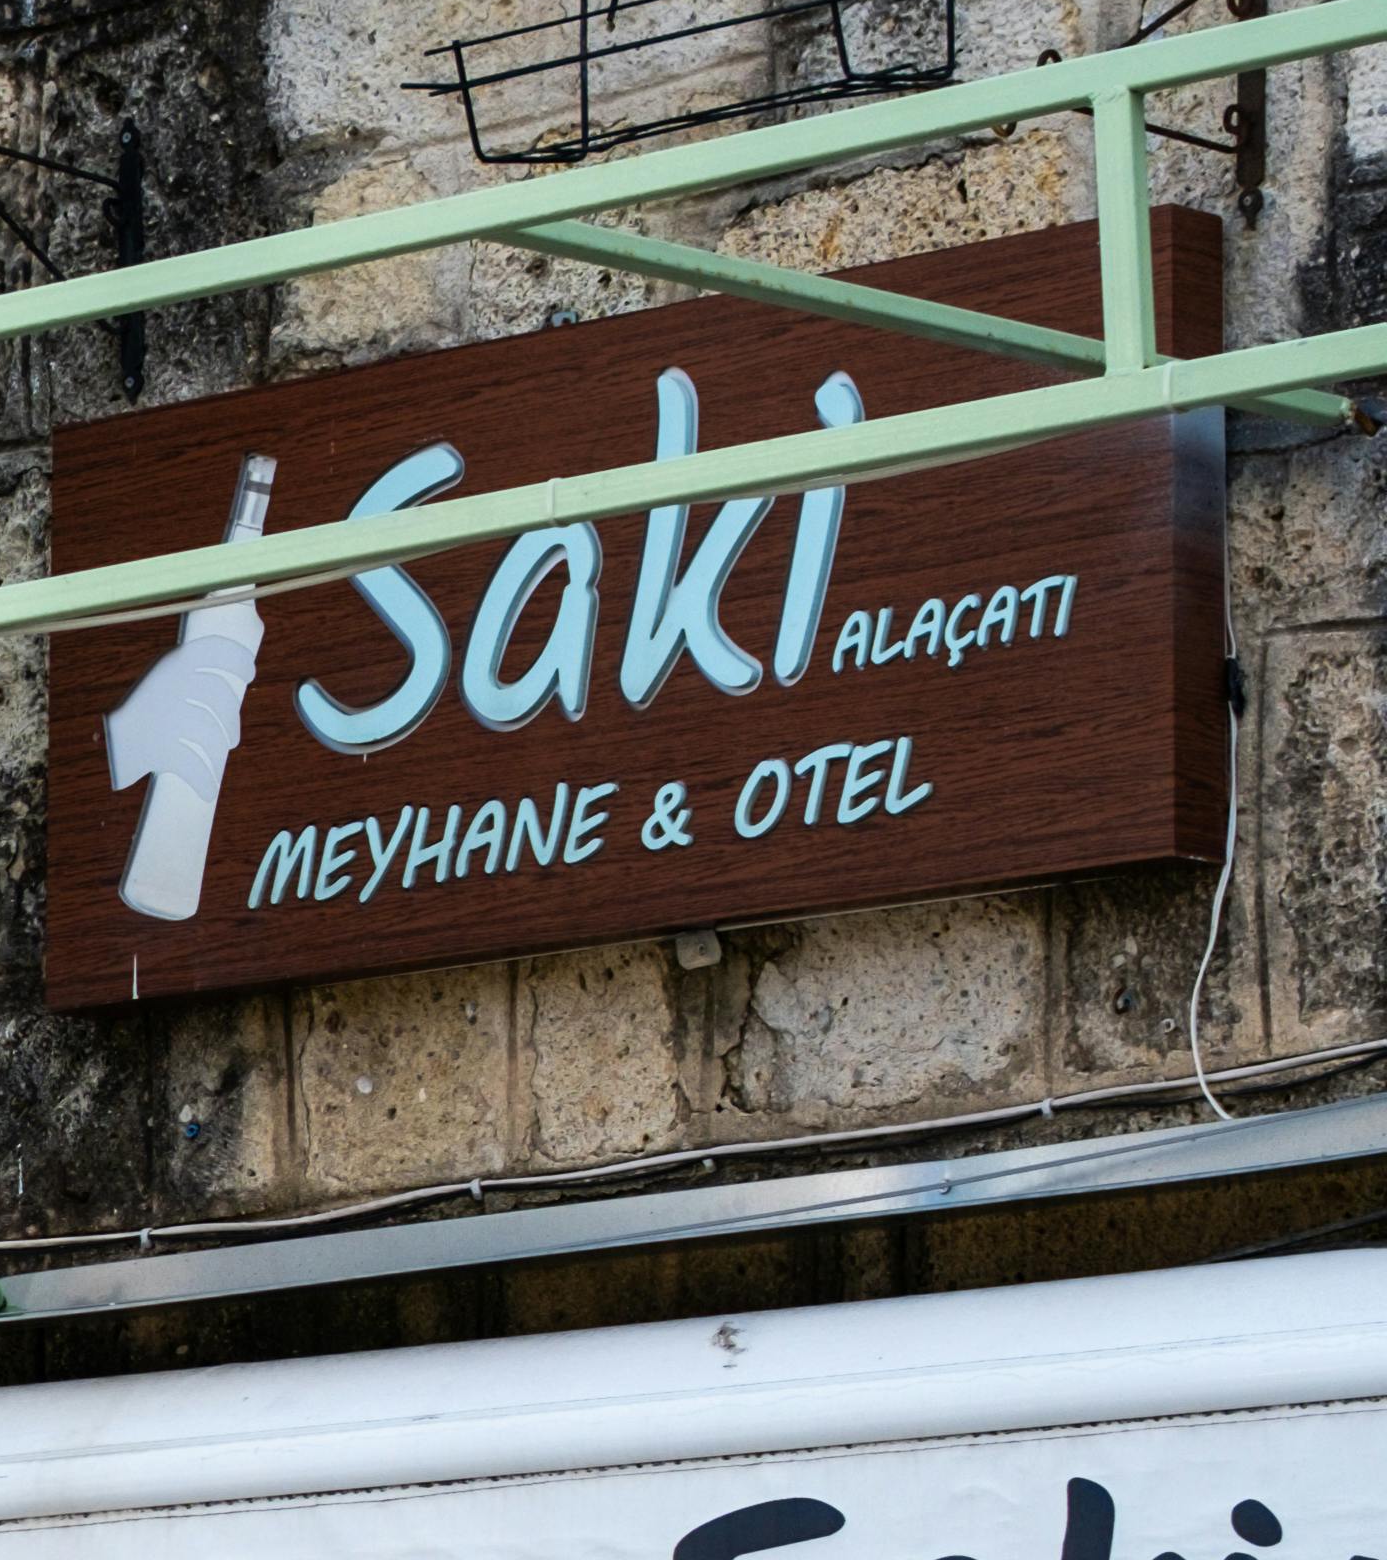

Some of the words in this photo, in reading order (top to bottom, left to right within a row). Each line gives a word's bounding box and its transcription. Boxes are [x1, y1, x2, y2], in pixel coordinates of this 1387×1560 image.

[292, 368, 867, 755] Saki
[831, 574, 1079, 674] ALAÇATI
[248, 781, 621, 911] MEYHANE
[640, 781, 693, 852] &
[733, 736, 933, 841] OTEL
